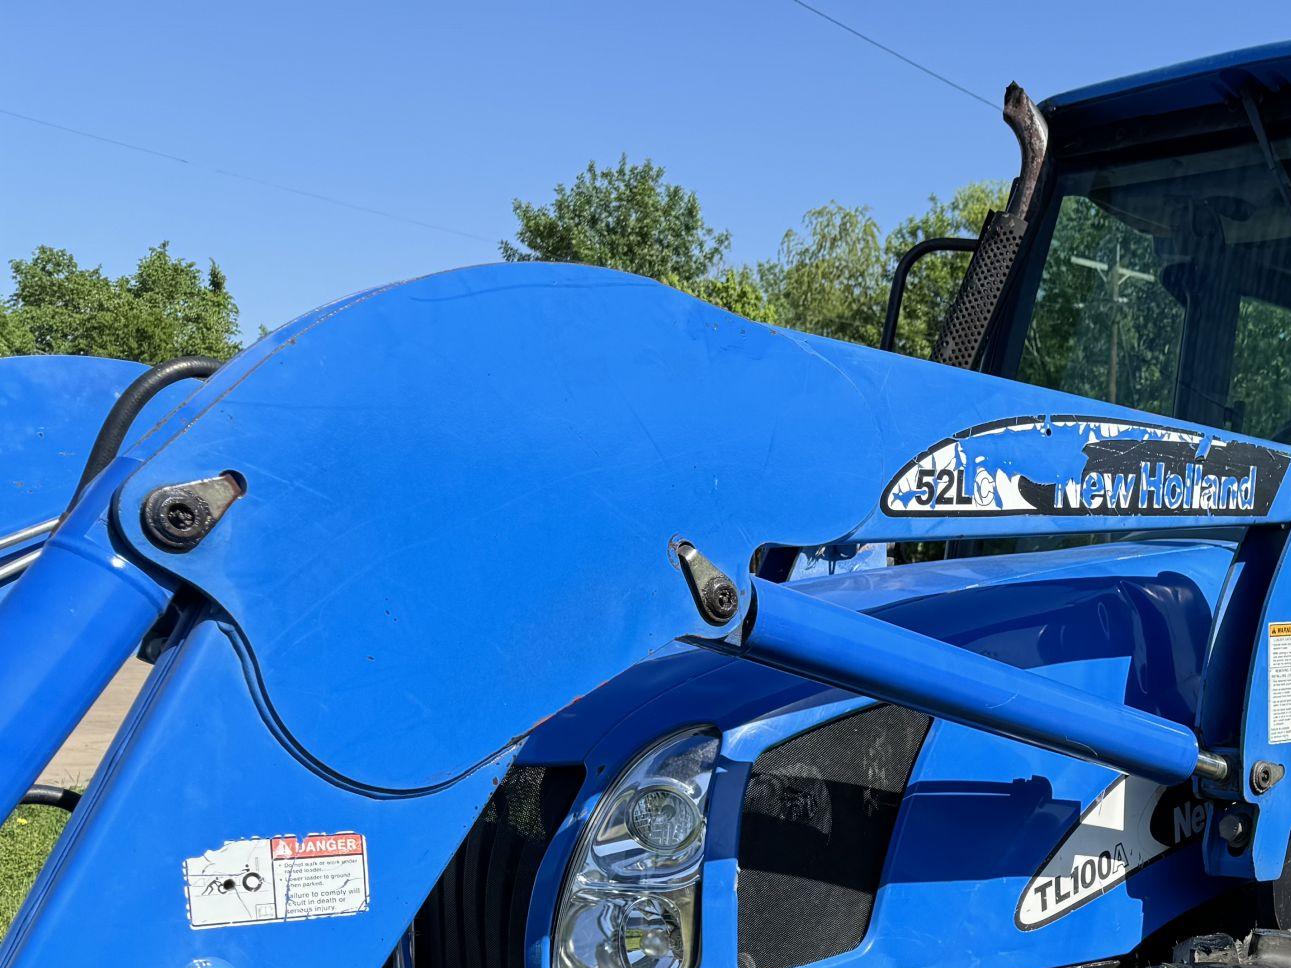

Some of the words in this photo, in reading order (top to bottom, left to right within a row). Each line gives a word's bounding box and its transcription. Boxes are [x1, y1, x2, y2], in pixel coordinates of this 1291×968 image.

[1138, 460, 1257, 510] Holland
[331, 873, 352, 881] ground
[1034, 842, 1130, 912] TL100A
[303, 881, 325, 889] parked.
[312, 891, 319, 899] to
[321, 890, 347, 900] comply
[348, 888, 361, 896] will
[315, 906, 336, 915] injury.
